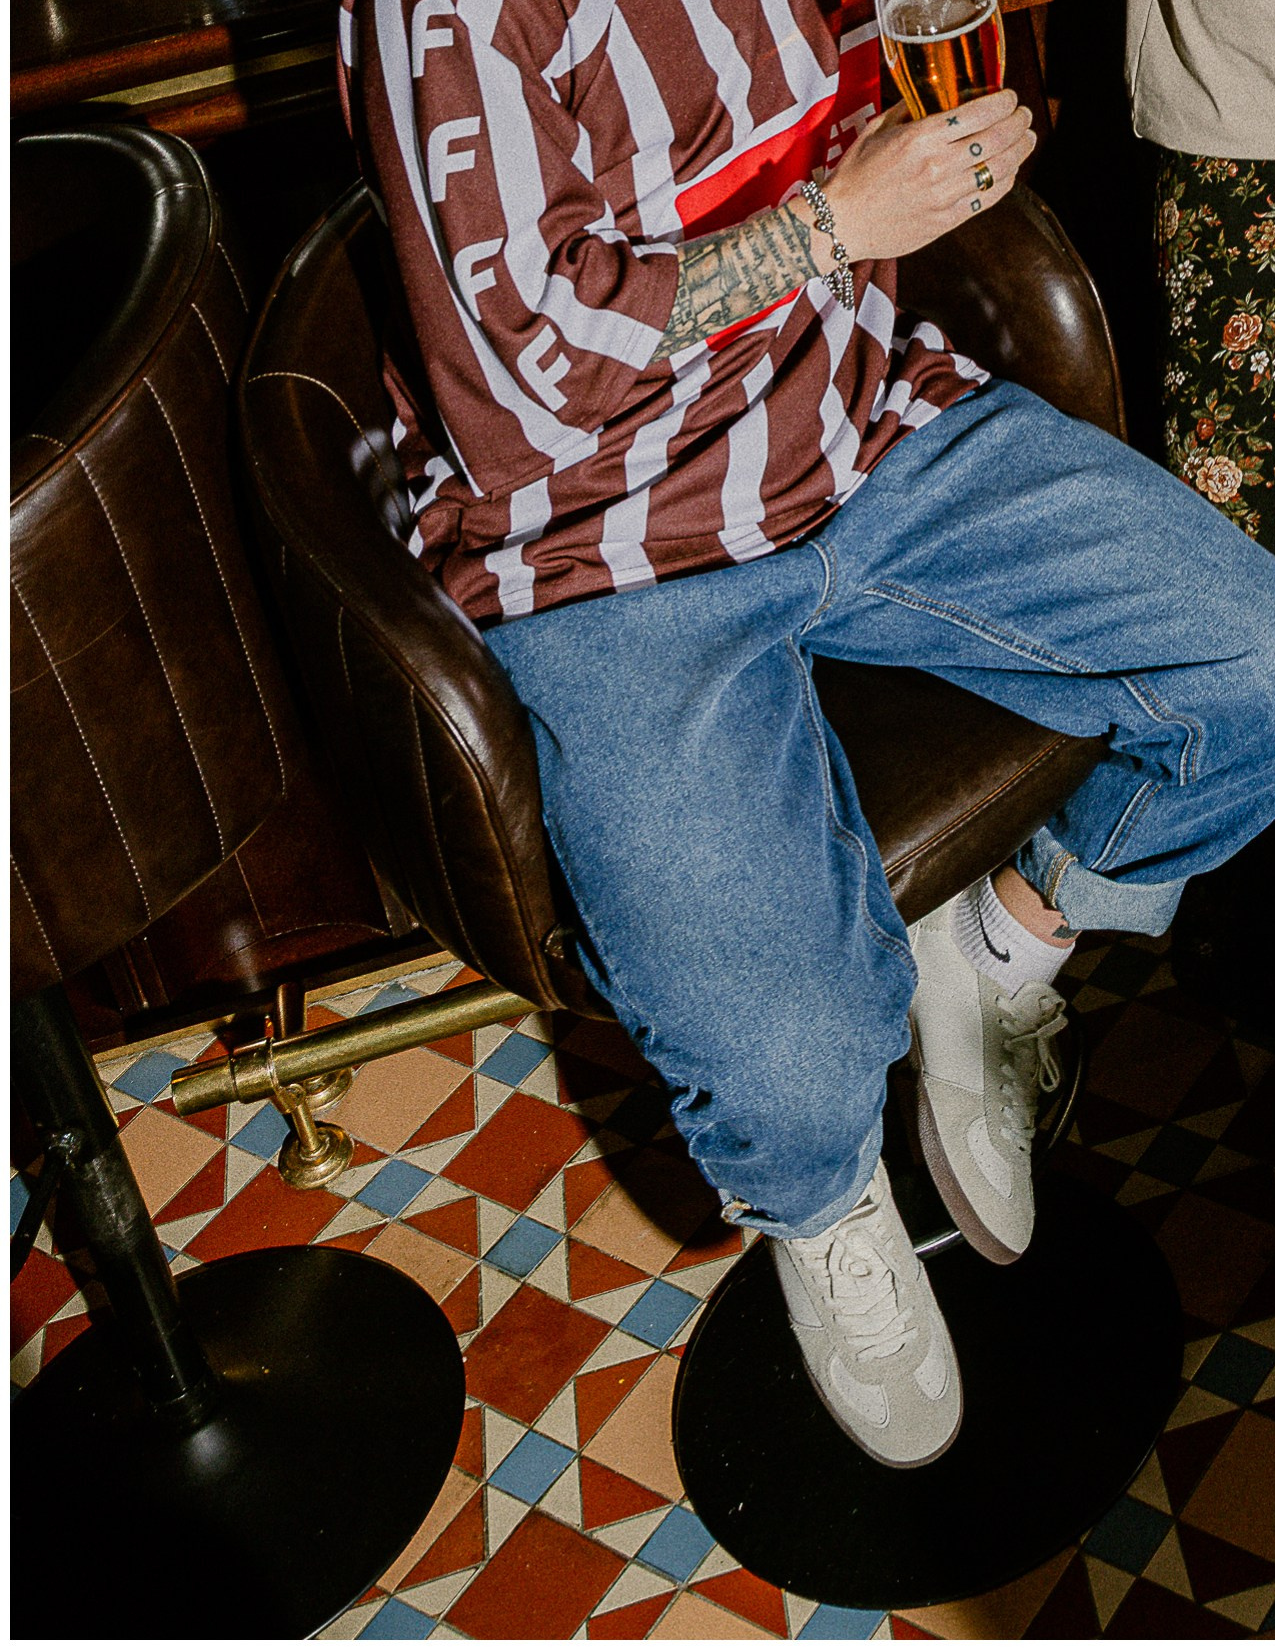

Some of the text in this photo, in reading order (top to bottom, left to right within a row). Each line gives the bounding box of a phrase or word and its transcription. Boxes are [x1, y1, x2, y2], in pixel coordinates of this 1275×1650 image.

[428, 115, 482, 202] F
[453, 237, 523, 322] F
[516, 324, 571, 413] F
